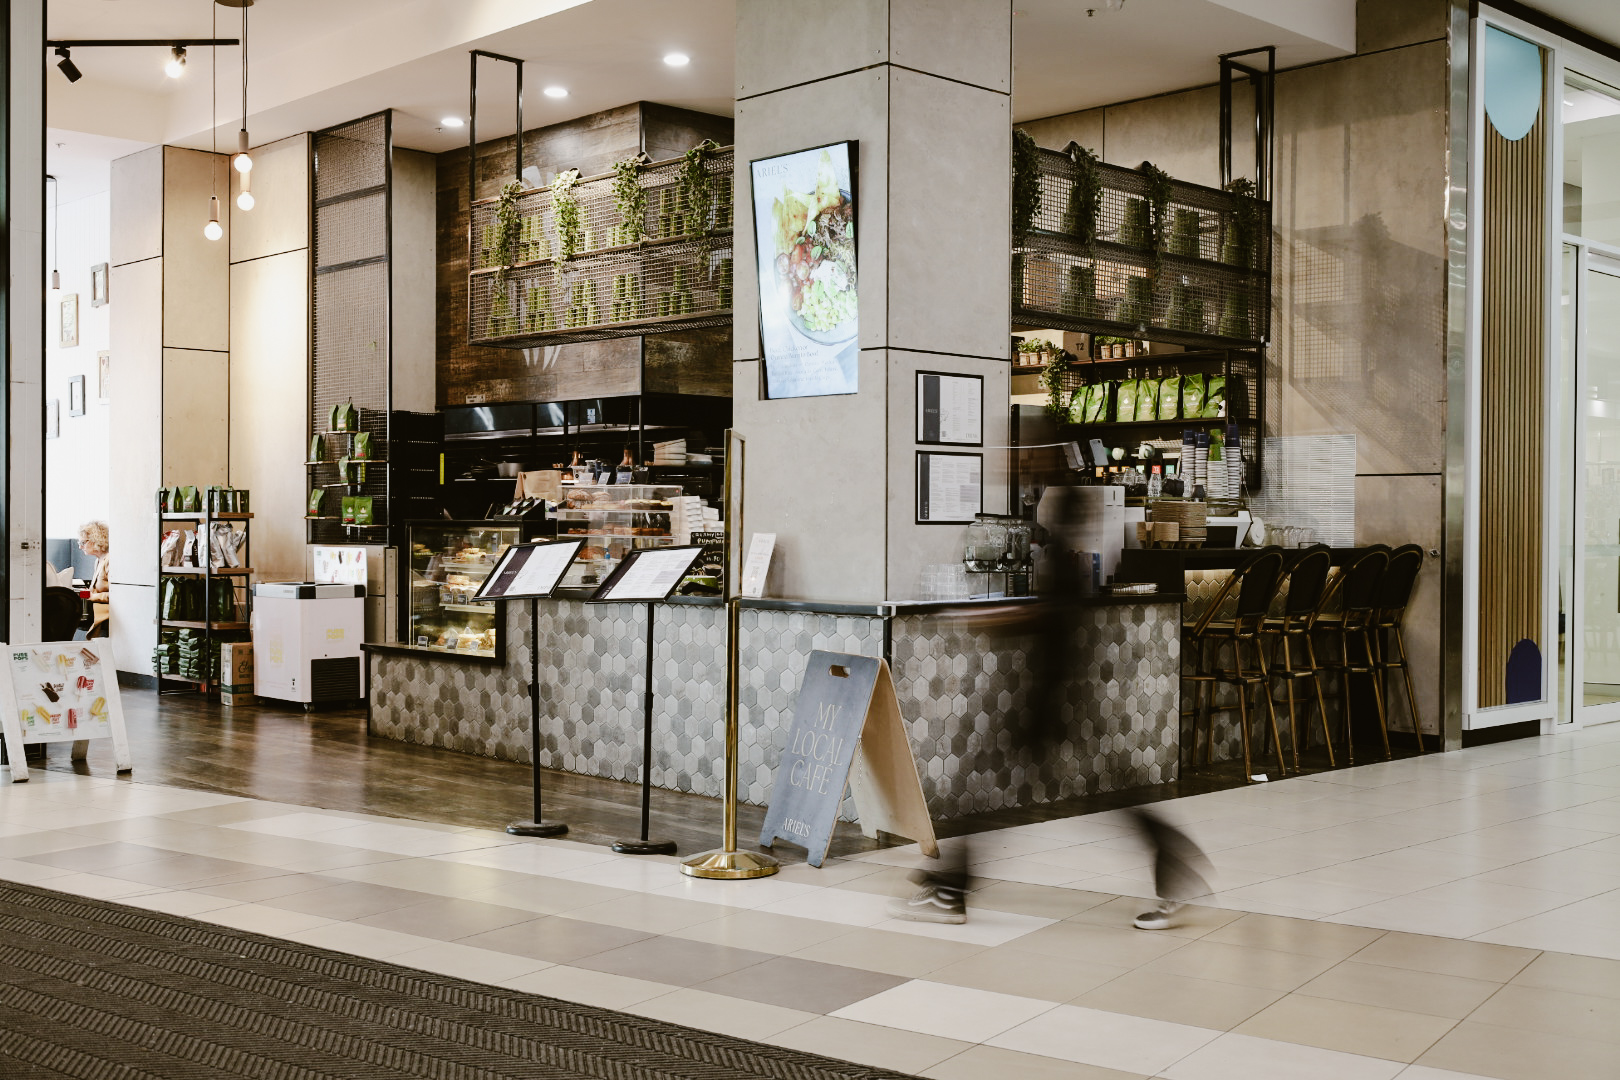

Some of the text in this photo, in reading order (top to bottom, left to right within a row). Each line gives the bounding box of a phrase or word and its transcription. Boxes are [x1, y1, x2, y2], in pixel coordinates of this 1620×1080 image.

[756, 164, 789, 178] ARIEL'S
[813, 701, 843, 731] MY
[791, 728, 845, 766] LOCAL
[790, 759, 832, 795] CAFÉ
[782, 817, 811, 838] ARIEL'S
